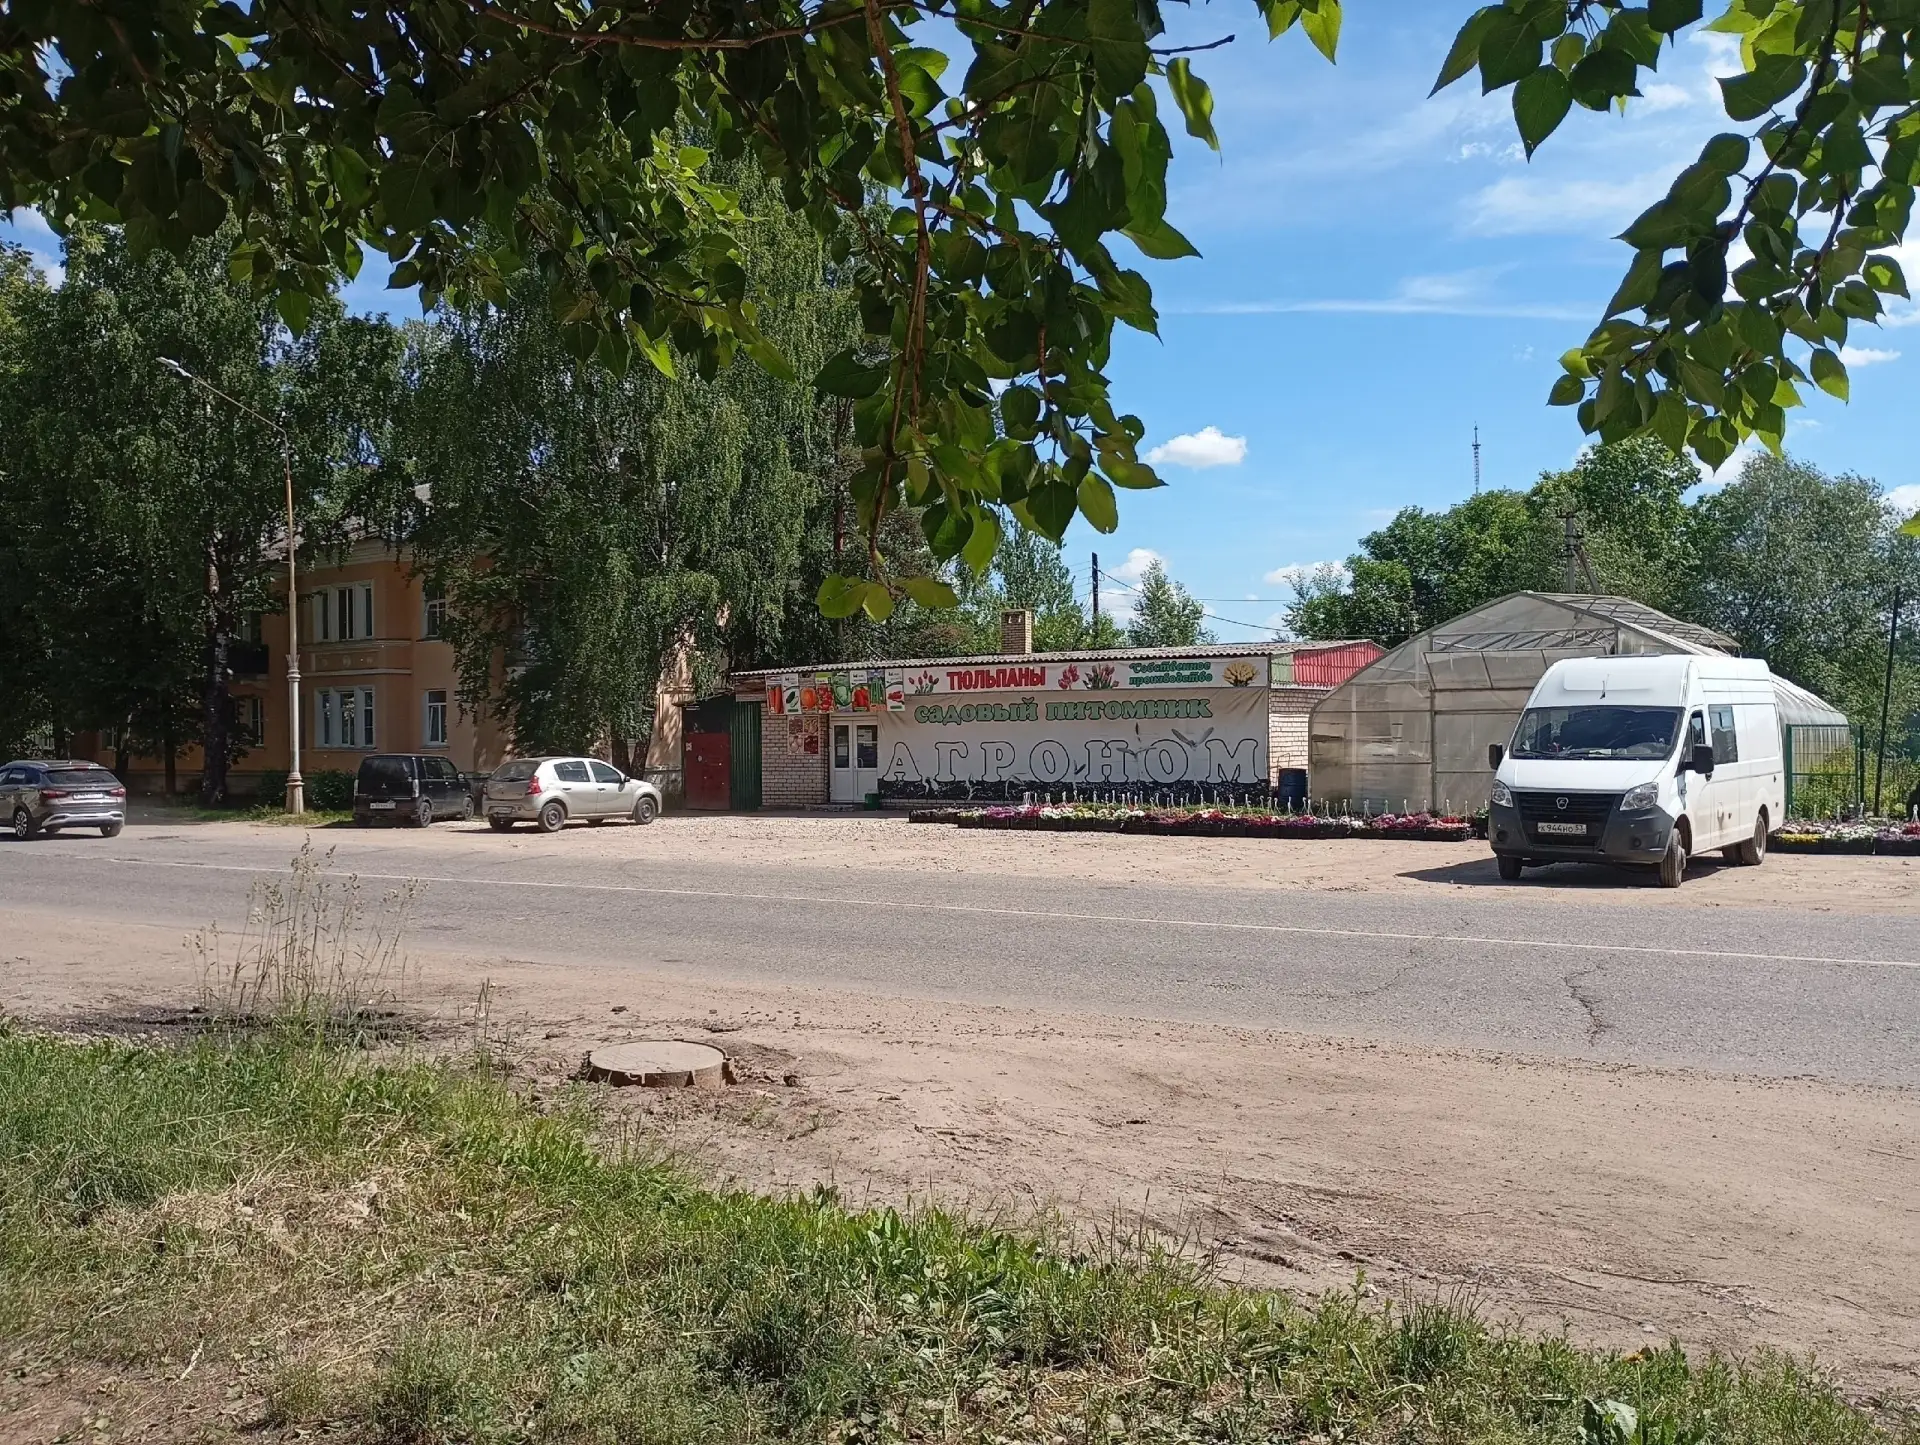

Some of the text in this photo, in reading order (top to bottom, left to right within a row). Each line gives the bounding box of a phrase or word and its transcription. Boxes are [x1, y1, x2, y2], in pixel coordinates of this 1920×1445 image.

[946, 666, 1046, 690] ТЮЛЬПАНЫ
[1128, 661, 1211, 673] Собственное
[1128, 671, 1213, 687] производство
[914, 696, 1038, 725] садовый
[882, 739, 1259, 783] АГРОНОМ
